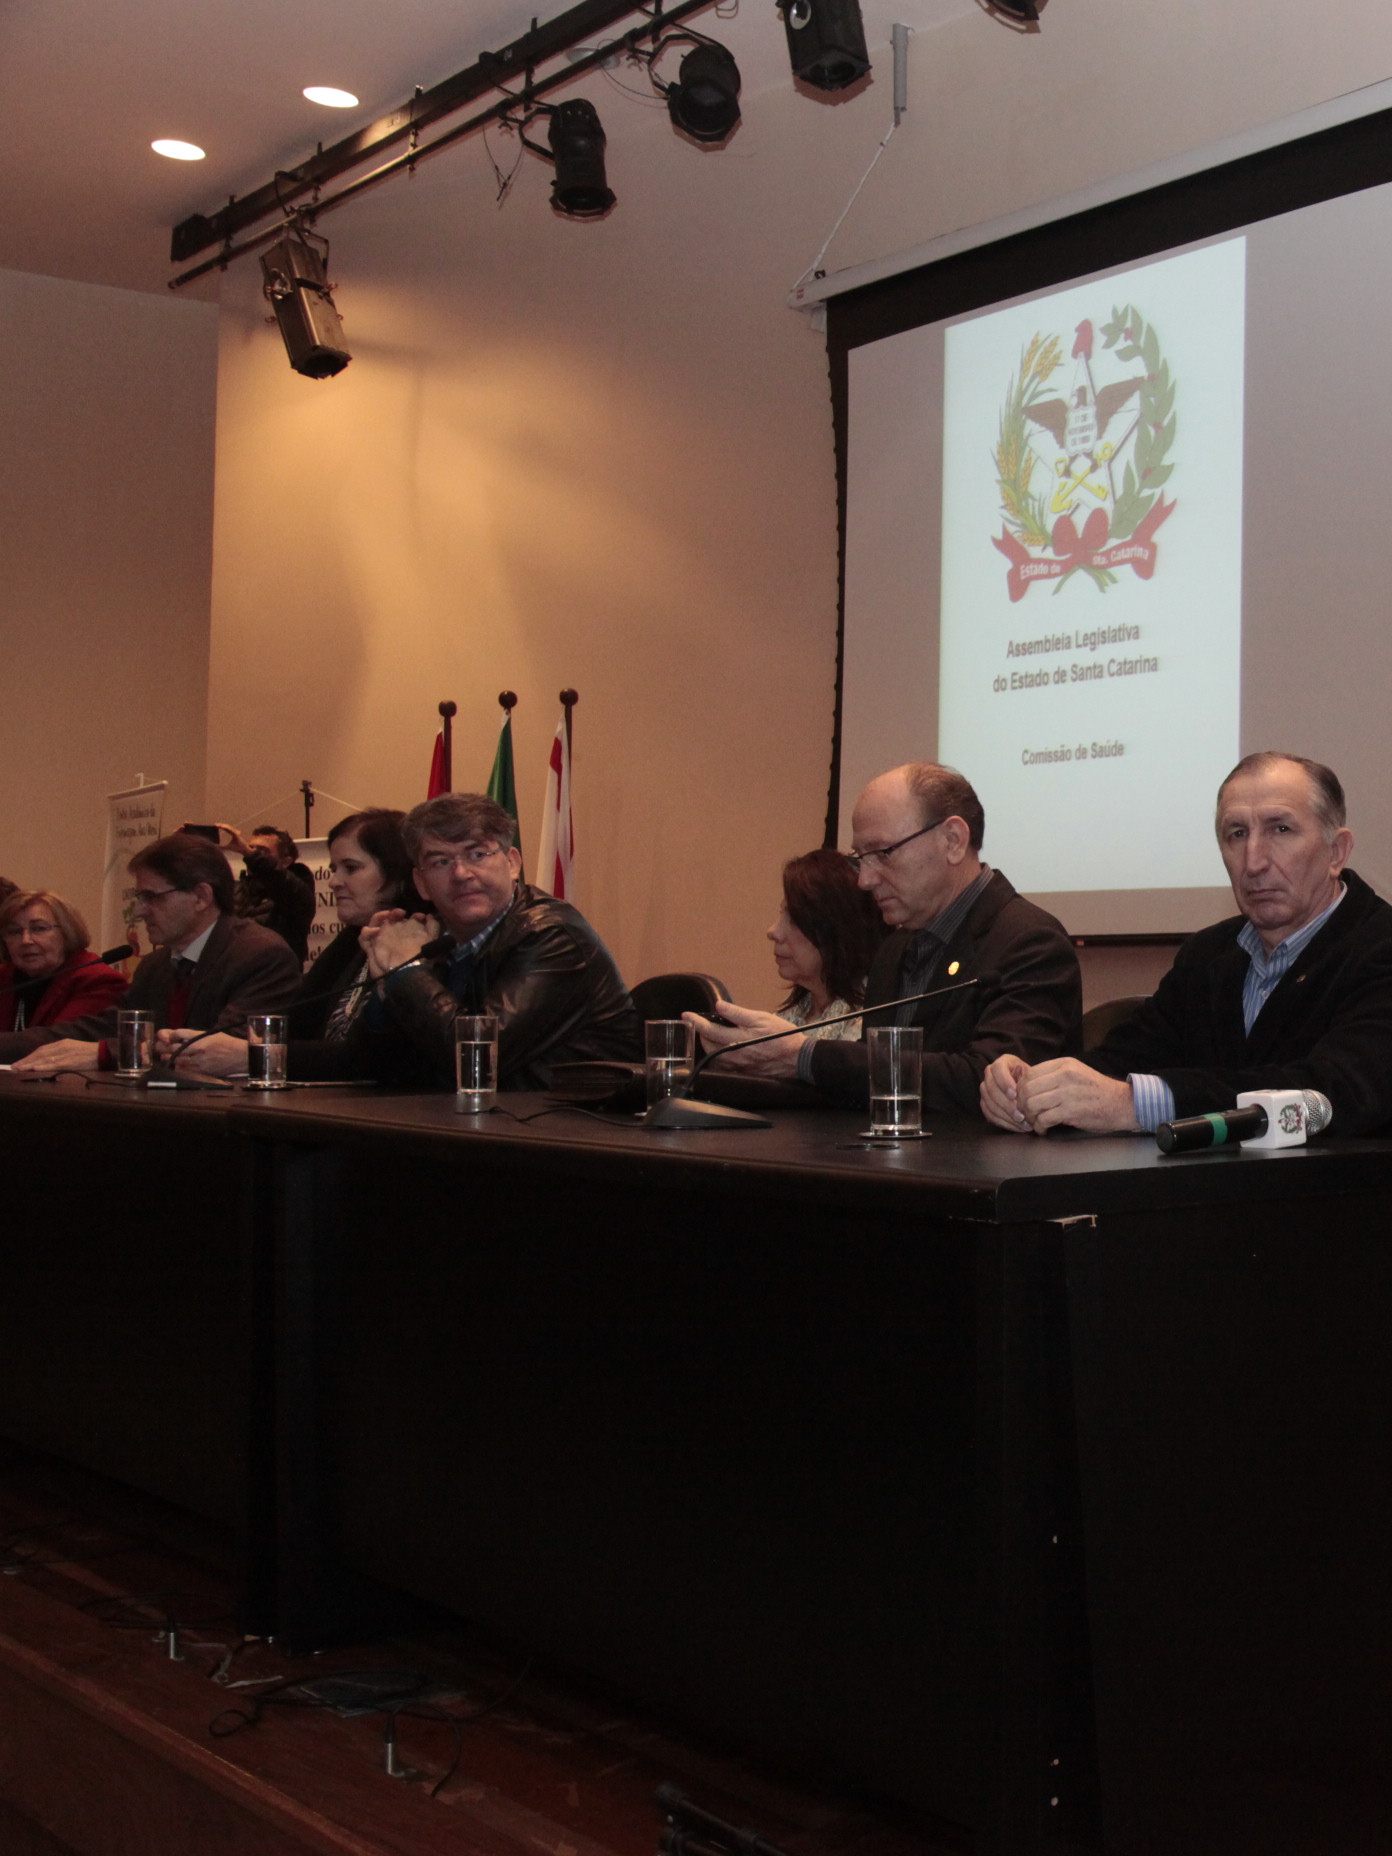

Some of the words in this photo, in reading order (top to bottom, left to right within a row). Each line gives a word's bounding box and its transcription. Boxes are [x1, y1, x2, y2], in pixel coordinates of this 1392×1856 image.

[1020, 564, 1049, 580] Estado
[1110, 544, 1149, 562] Catarina
[1006, 632, 1072, 658] Assembleia
[1075, 622, 1140, 652] Legislativa
[993, 674, 1007, 692] do
[1010, 669, 1049, 690] Estado
[1053, 666, 1067, 685] de
[1071, 662, 1104, 682] Santa
[1107, 655, 1158, 677] Catarina
[1022, 744, 1072, 765] Comissão
[1075, 744, 1088, 760] de
[1091, 740, 1125, 759] Saúde
